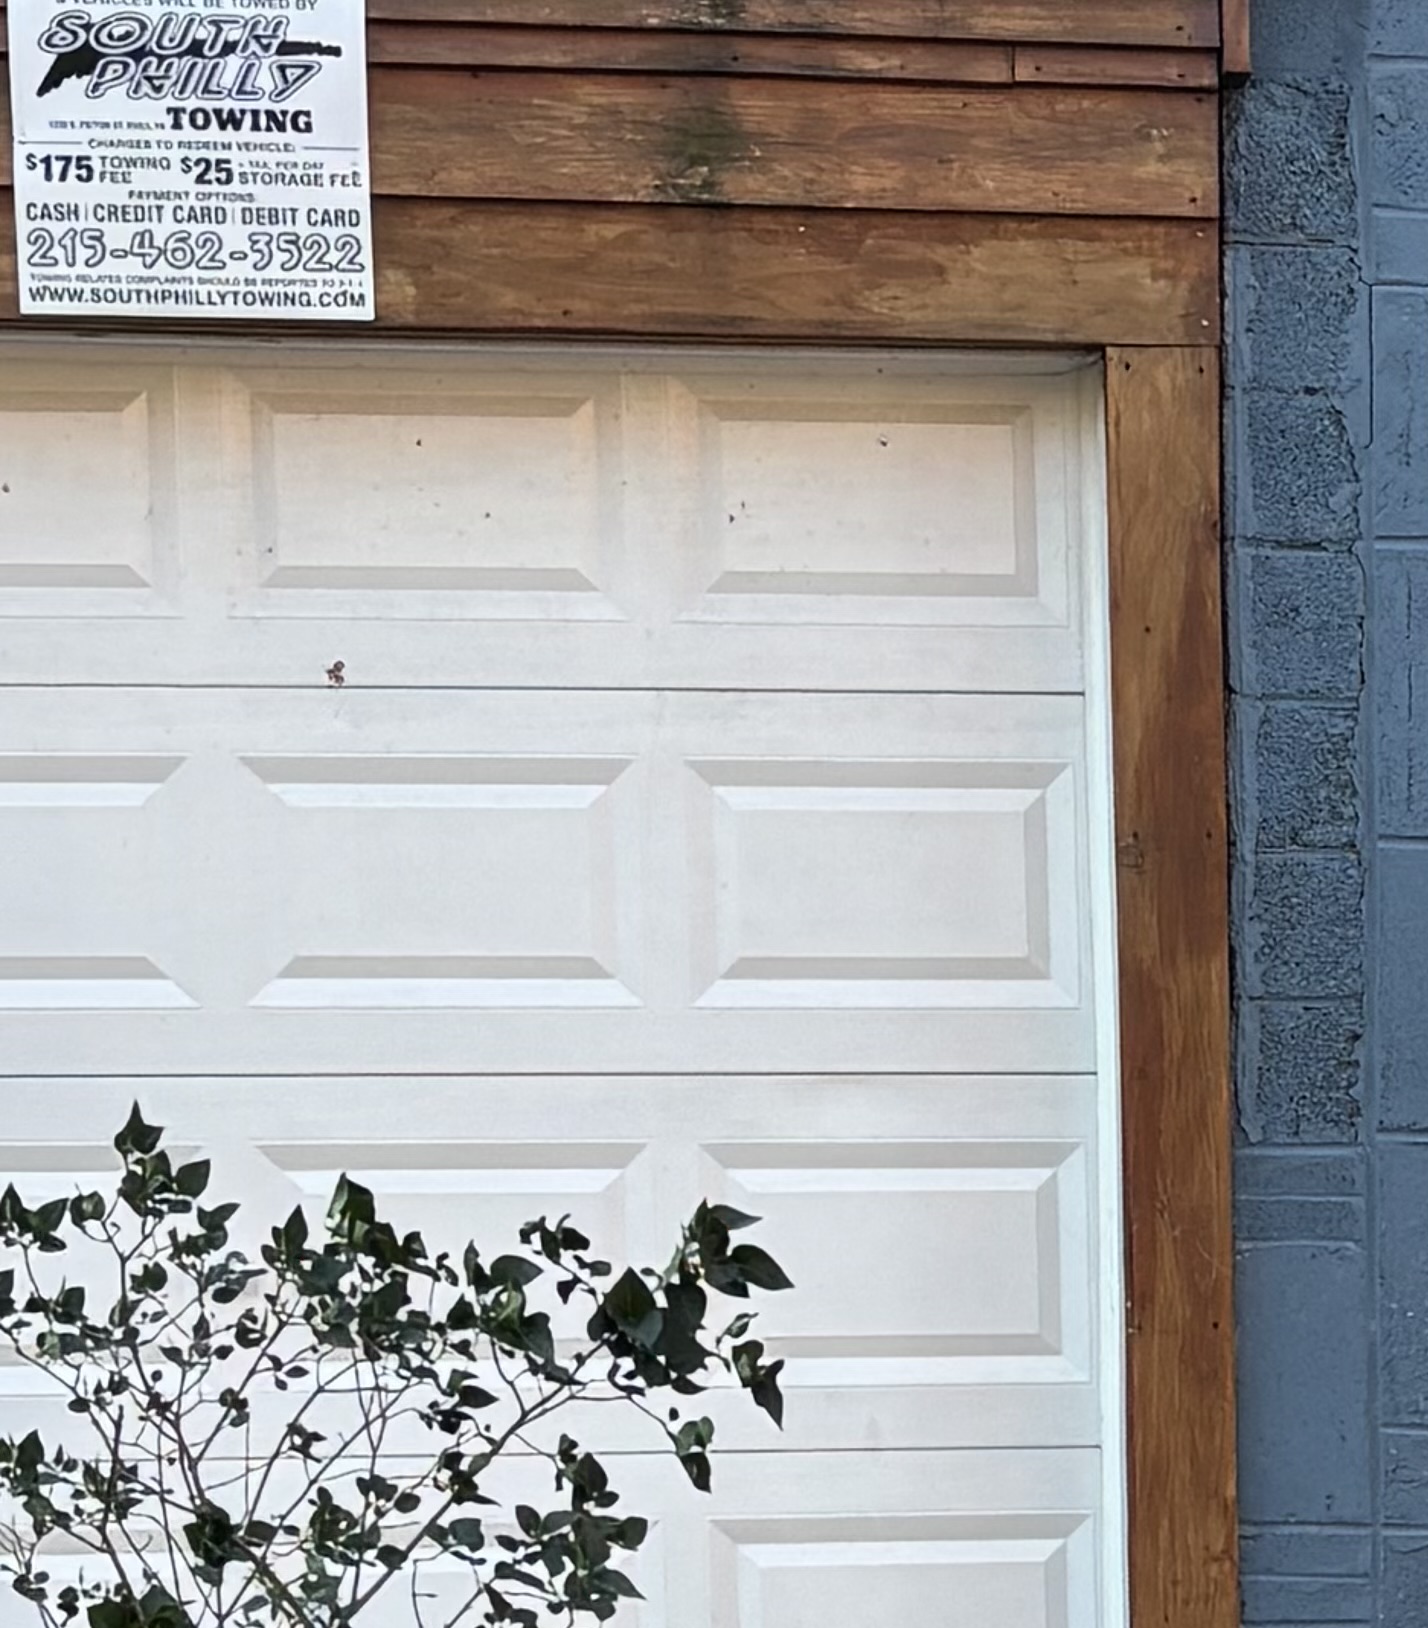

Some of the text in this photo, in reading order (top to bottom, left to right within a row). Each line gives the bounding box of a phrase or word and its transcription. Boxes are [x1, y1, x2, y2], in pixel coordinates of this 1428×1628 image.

[38, 10, 290, 58] SOUTH
[85, 56, 322, 103] PHILLY
[166, 107, 313, 134] TOWING
[25, 152, 94, 183] $175
[98, 155, 171, 170] TOWING
[180, 156, 234, 186] $25
[99, 171, 362, 187] FEE STORAGE FEE
[26, 202, 361, 227] CASH CREDIT CARD DEBIT CARD
[27, 227, 366, 273] 215-462-3522
[28, 285, 366, 308] WWW.SOUTHPHILLYTOWING.COM
